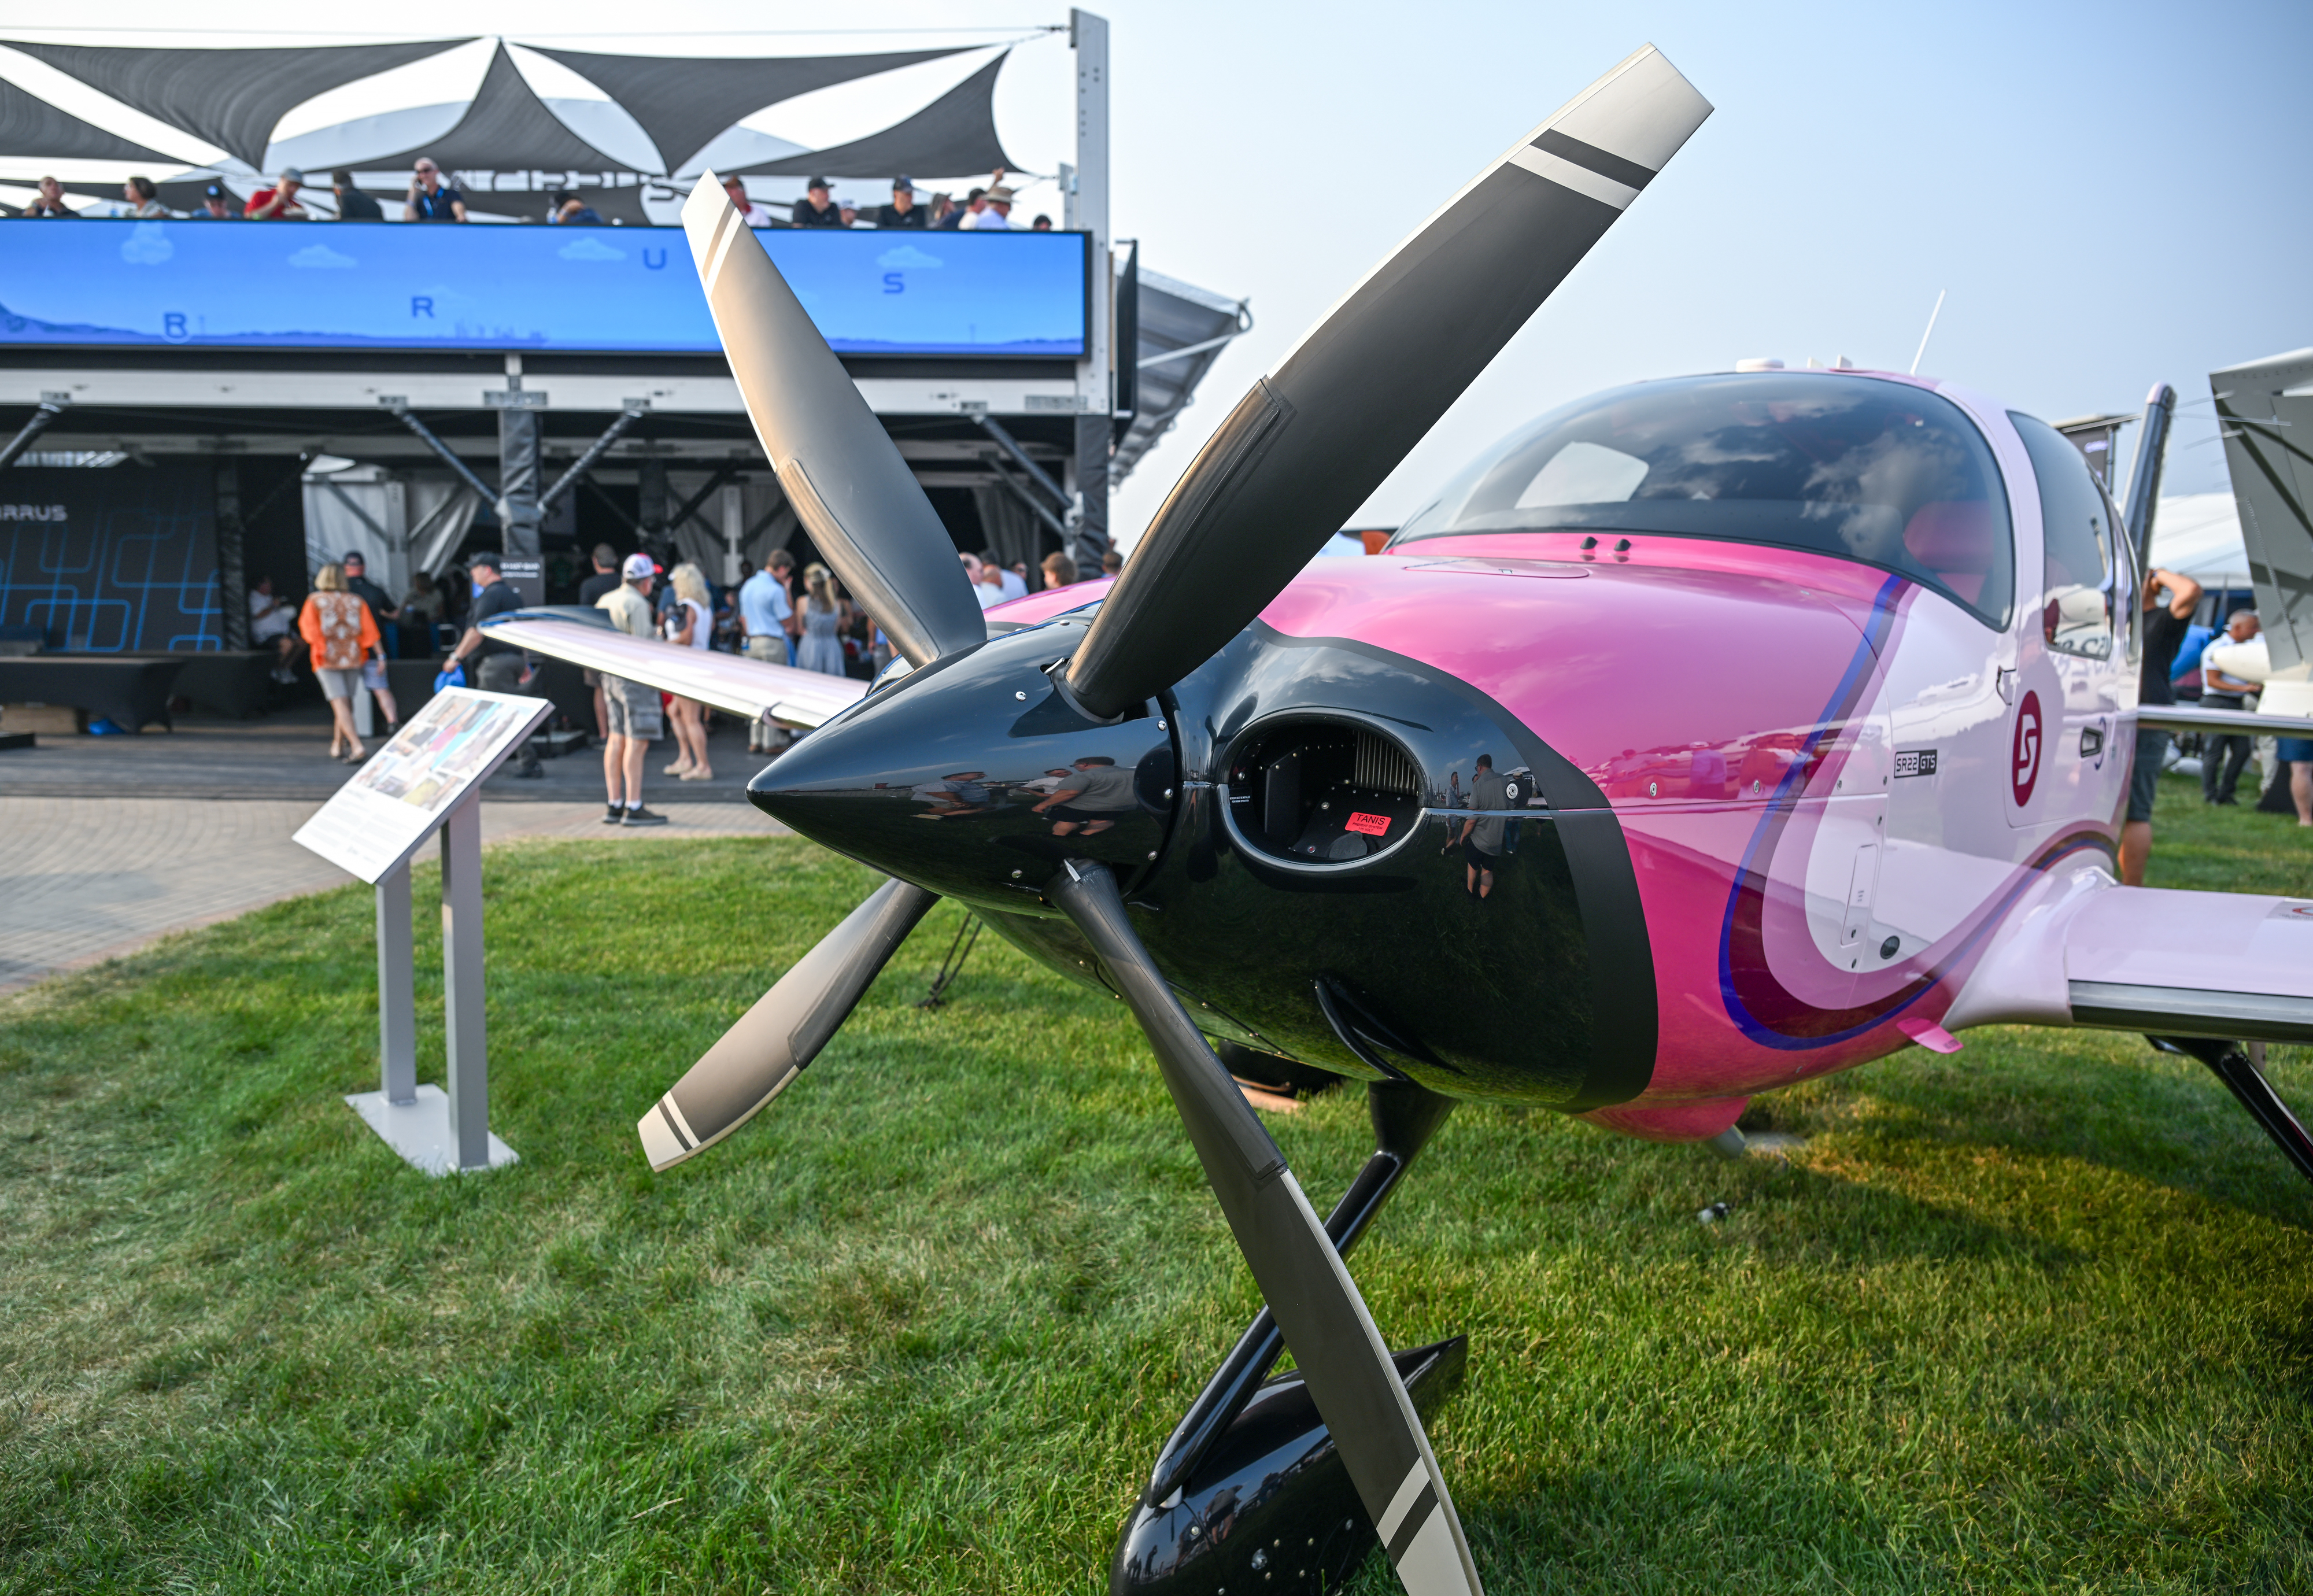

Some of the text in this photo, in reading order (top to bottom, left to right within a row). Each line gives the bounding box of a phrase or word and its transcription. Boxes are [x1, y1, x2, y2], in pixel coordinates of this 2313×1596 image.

[643, 247, 666, 270] U
[884, 273, 904, 294] S
[412, 296, 434, 317] R
[1897, 755, 1935, 771] SR22 GTS
[1357, 814, 1385, 825] TANIS
